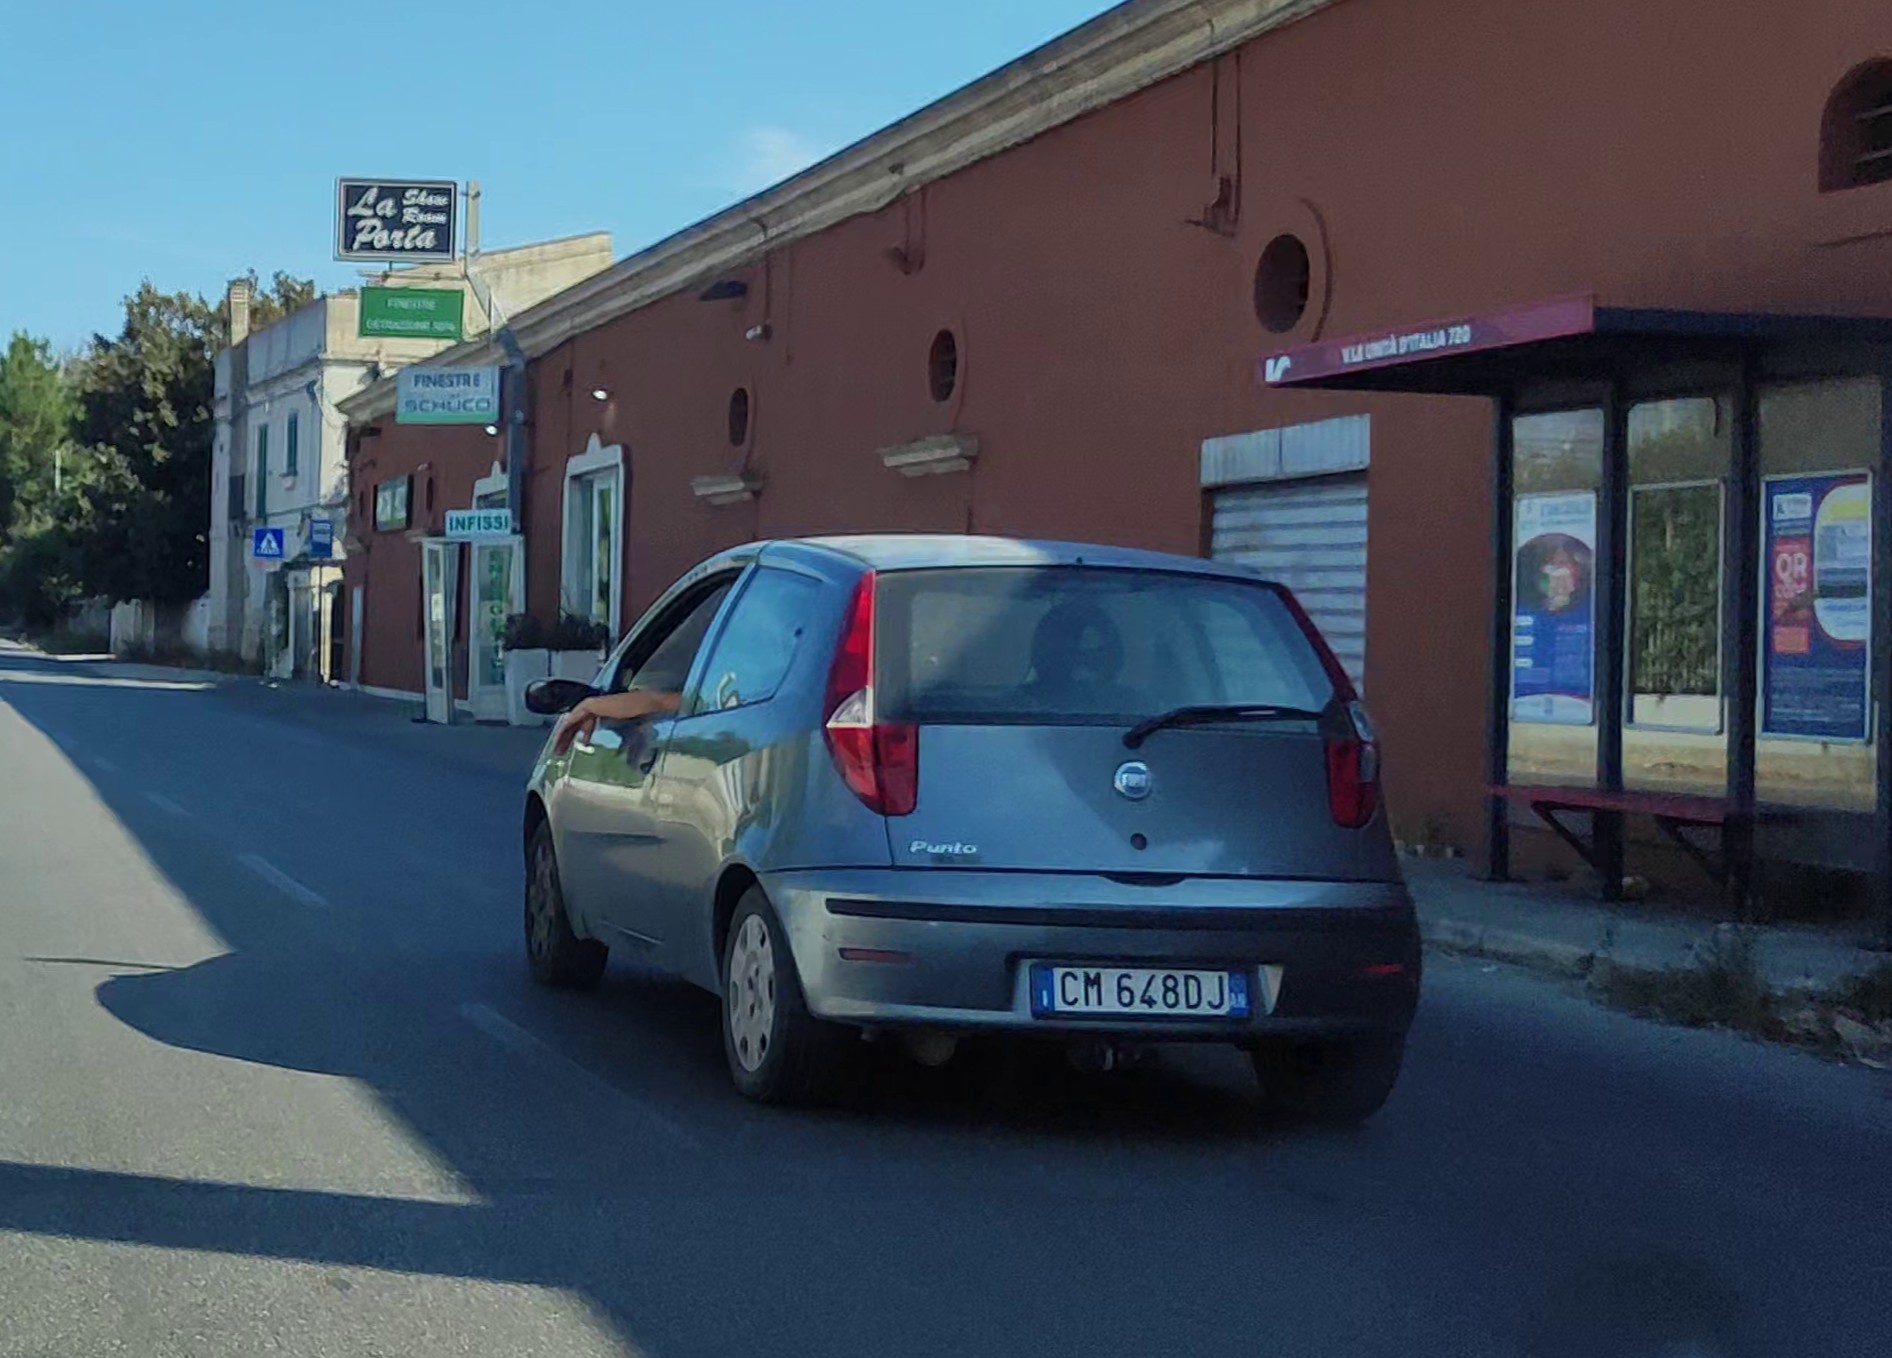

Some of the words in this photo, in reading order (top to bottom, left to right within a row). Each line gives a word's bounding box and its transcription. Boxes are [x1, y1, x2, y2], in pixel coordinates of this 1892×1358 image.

[347, 187, 397, 218] La
[352, 217, 436, 251] Porta
[414, 373, 481, 388] FINESTRE
[449, 516, 508, 531] INFISSI
[910, 840, 977, 854] Punto
[1060, 971, 1103, 1007] CM
[1116, 973, 1225, 1010] 648DJ
